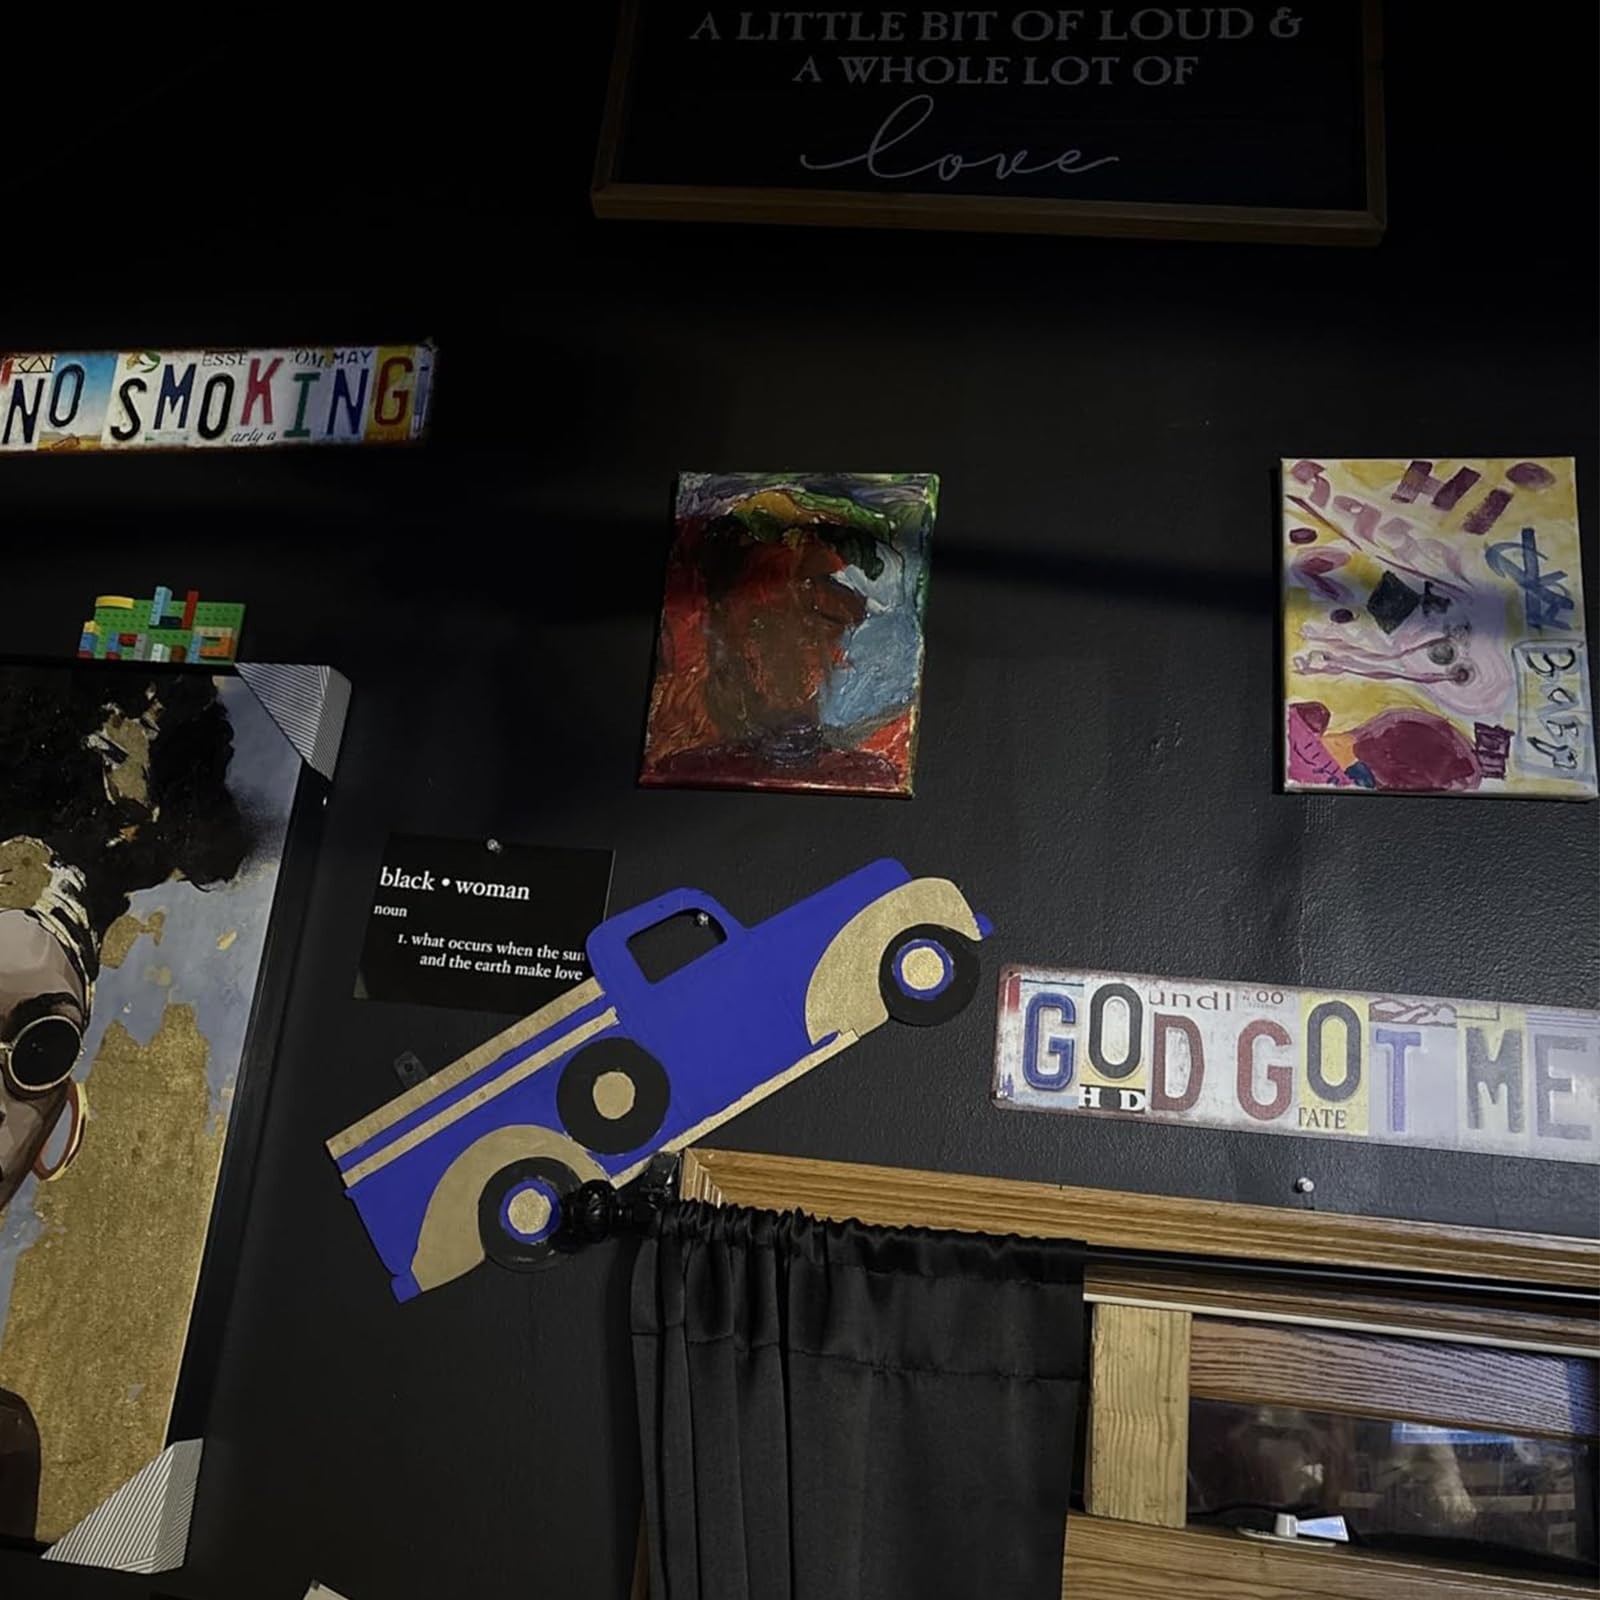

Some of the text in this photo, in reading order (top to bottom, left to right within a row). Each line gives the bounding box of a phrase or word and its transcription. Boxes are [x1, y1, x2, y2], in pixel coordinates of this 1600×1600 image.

[690, 8, 1305, 44] A LITTLE BIT OF LOUD &
[793, 56, 1200, 87] A WHOLE LOT OF
[799, 94, 1120, 183] love
[334, 351, 372, 365] MAY
[2, 355, 412, 444] NO SMOKING
[379, 866, 530, 901] black woman
[373, 902, 409, 918] noun
[411, 932, 446, 950] what
[448, 939, 494, 955] occurs
[496, 940, 534, 960] when
[537, 944, 560, 962] the
[562, 948, 587, 963] sun
[419, 951, 584, 982] and the earth make love
[1021, 982, 1598, 1142] GOD GOT ME
